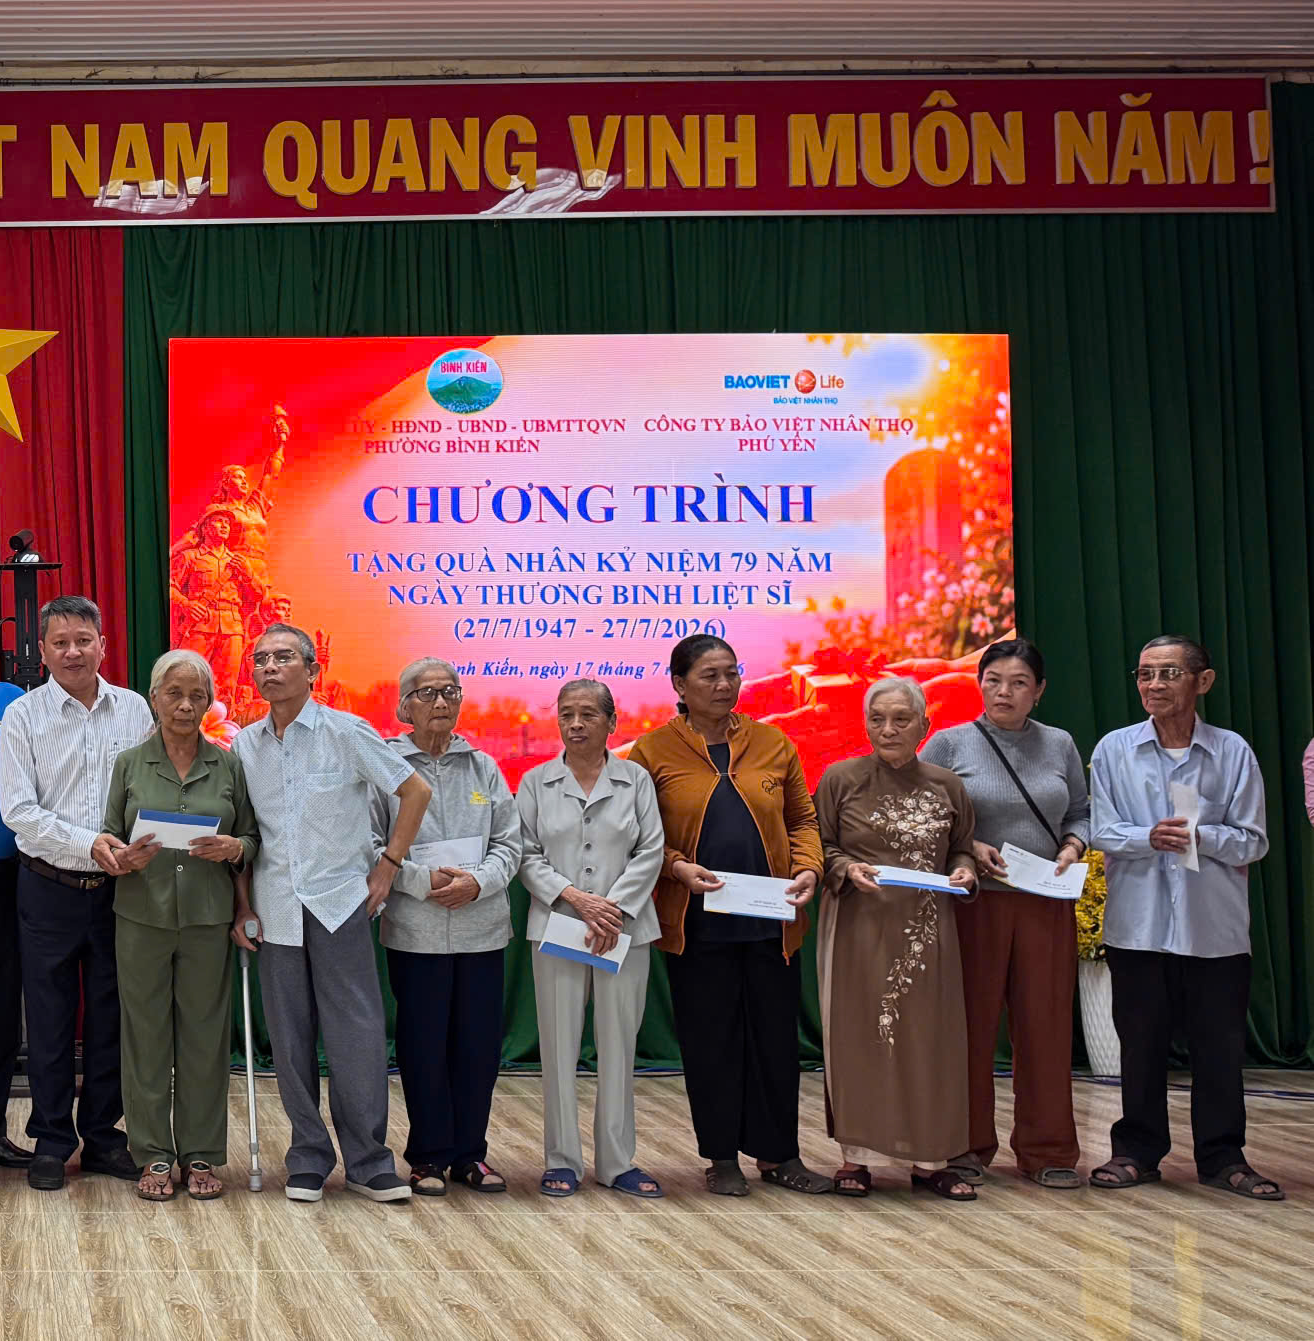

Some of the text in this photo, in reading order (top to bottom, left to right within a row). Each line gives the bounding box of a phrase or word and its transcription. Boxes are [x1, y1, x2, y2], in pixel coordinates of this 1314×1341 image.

[50, 122, 228, 198] NAM
[263, 114, 537, 209] QUANG
[568, 114, 756, 188] VINH
[788, 90, 1026, 187] MUÔN
[724, 375, 844, 389] BAOVIET Life
[392, 420, 442, 433] HĐND
[458, 420, 507, 433] UBND
[523, 419, 626, 434] UBMTTQVN
[644, 414, 914, 436] CÔNG TY BẢO VIỆT NHÂN THỌ
[364, 436, 441, 454] PHƯỜNG
[446, 436, 490, 453] BÌNH
[738, 436, 775, 452] PHÚ
[363, 473, 817, 524] CHƯƠNG TRÌNH
[347, 546, 832, 578] TẶNG QUÀ NHÂN KỶ NIỆM 79 NĂM
[389, 579, 792, 610] NGÀY THƯƠNG BINH LIỆT SĨ
[454, 617, 576, 643] (27/7/1947
[602, 617, 726, 640] 27/7/2026)
[482, 657, 524, 678] Kiến,
[529, 662, 568, 679] ngày
[574, 662, 594, 675] 17
[597, 661, 645, 679] tháng
[652, 662, 661, 675] 7
